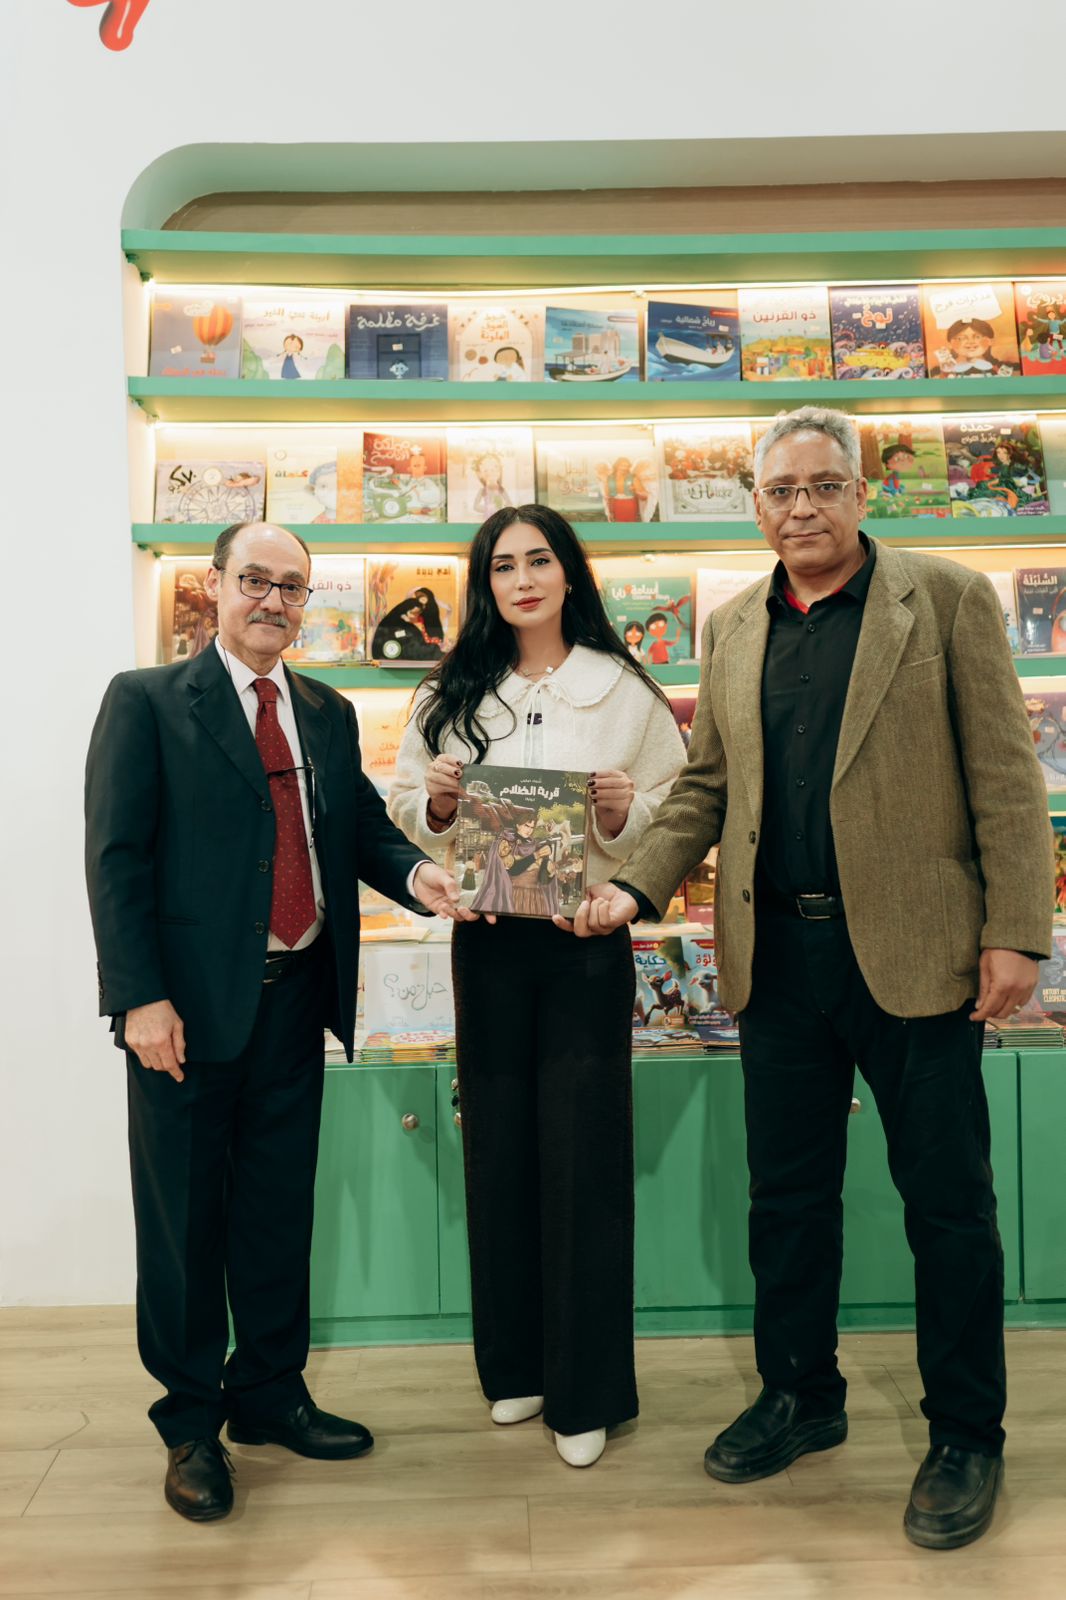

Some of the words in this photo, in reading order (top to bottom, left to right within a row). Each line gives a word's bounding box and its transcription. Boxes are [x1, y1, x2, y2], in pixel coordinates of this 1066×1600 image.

[356, 310, 402, 330] مظلمة
[404, 311, 441, 332] غرفة
[752, 310, 798, 324] القرنين
[801, 309, 817, 322] ذو
[336, 579, 353, 594] ذو
[499, 783, 537, 798] الظلام
[537, 786, 560, 801] قرية
[635, 953, 667, 968] حكاية
